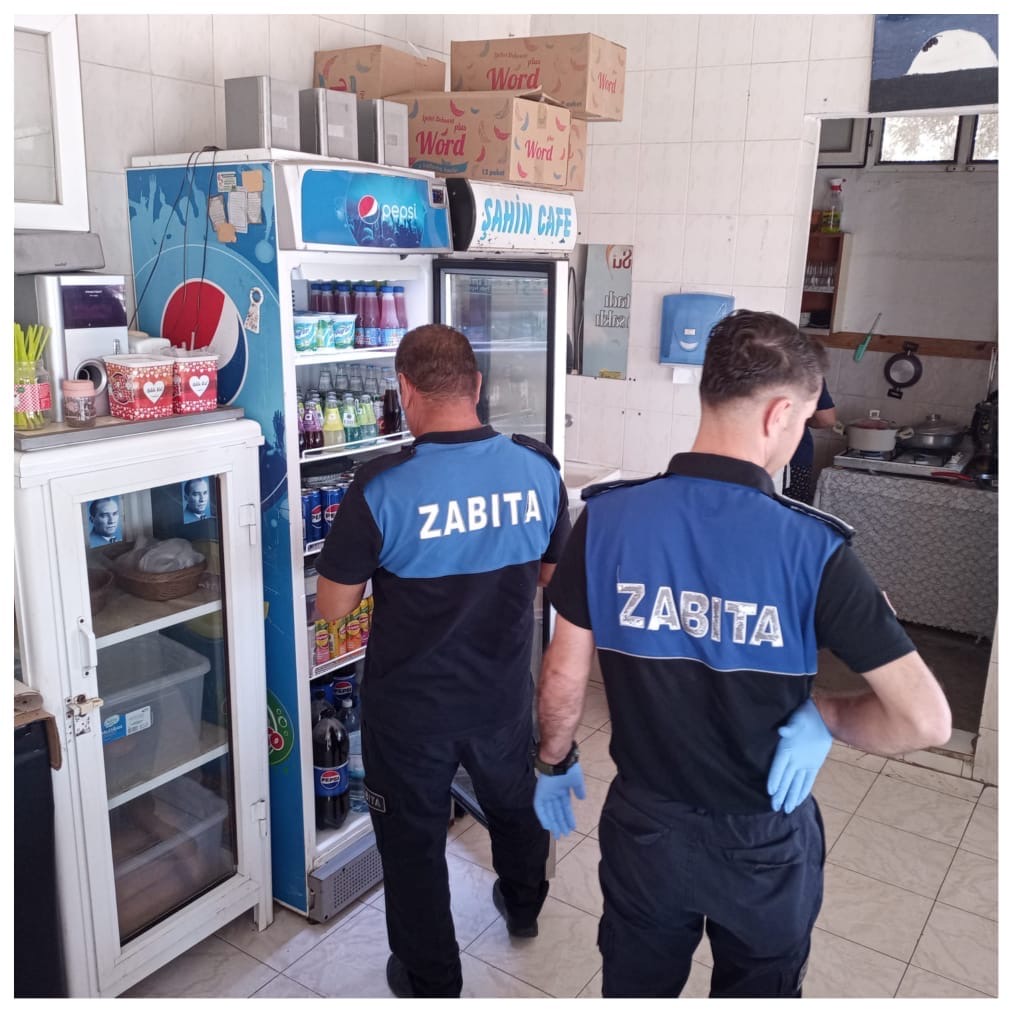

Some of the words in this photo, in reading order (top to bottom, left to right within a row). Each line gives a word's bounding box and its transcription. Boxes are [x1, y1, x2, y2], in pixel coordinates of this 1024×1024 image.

[486, 67, 541, 91] Word
[597, 72, 617, 94] Word
[415, 130, 467, 157] Word
[524, 139, 554, 161] Word
[381, 202, 417, 221] pepsi
[480, 193, 533, 241] ŞAHİN
[538, 204, 572, 238] CAFE
[418, 489, 542, 540] ZABITA
[616, 582, 784, 648] ZABITA
